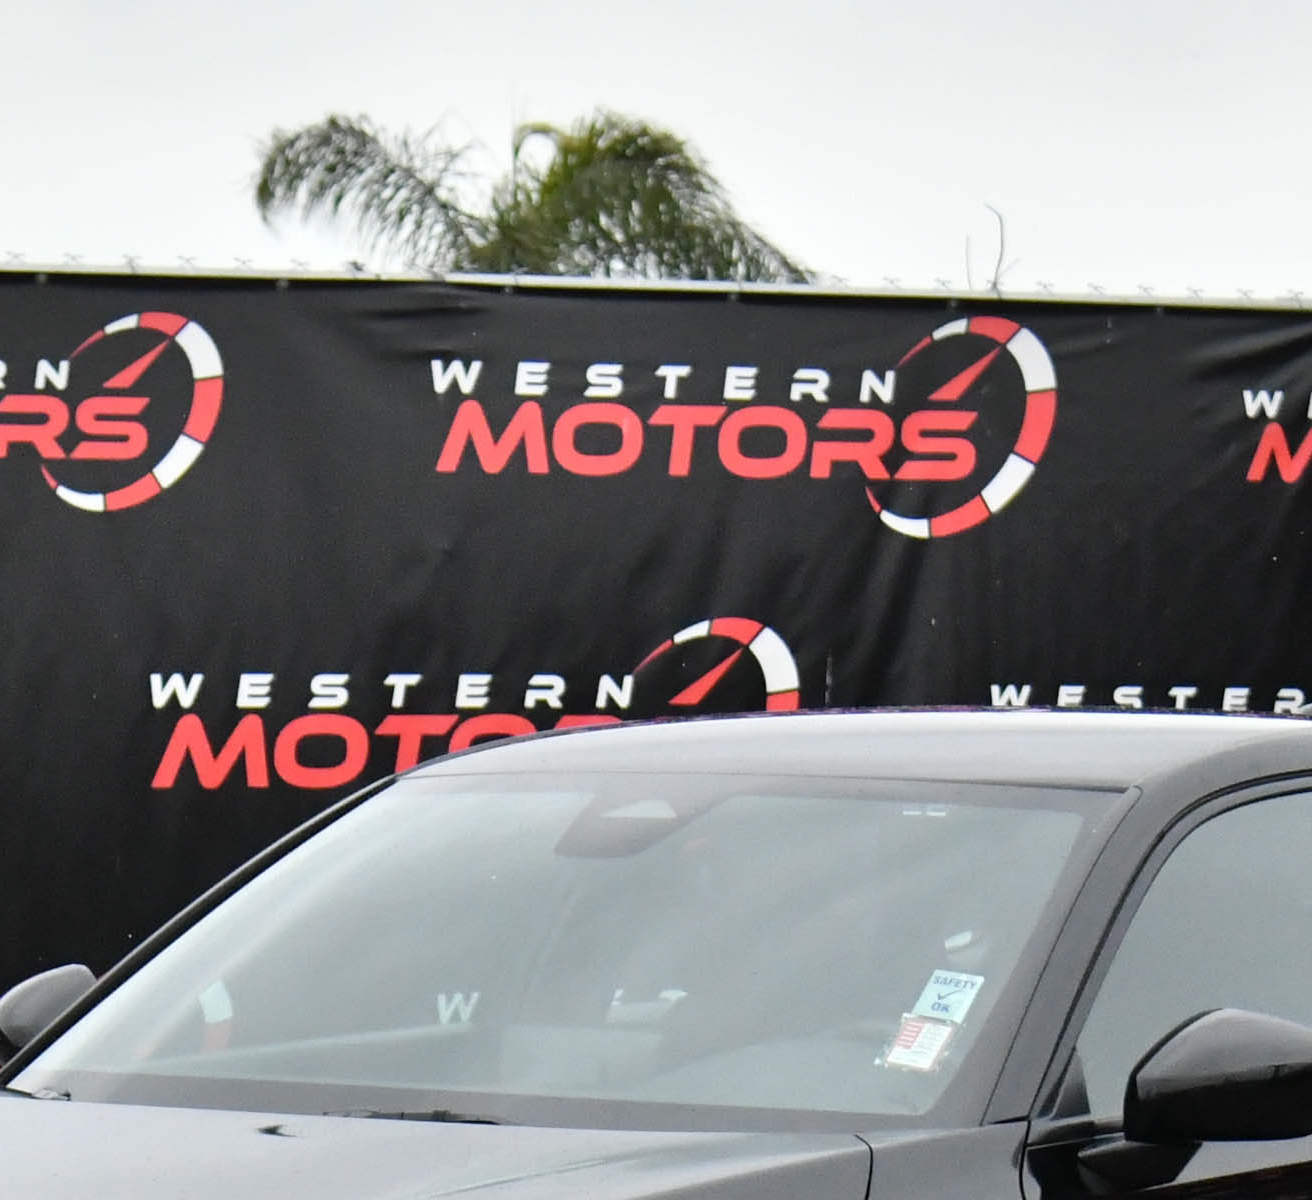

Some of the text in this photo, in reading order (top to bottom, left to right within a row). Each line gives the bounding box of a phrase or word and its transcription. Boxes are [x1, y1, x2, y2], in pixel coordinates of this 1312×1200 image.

[431, 359, 896, 404] WESTERN
[436, 400, 978, 482] MOTORS
[149, 673, 635, 709] WESTERN
[151, 713, 621, 791] MOT
[931, 1002, 950, 1013] OK
